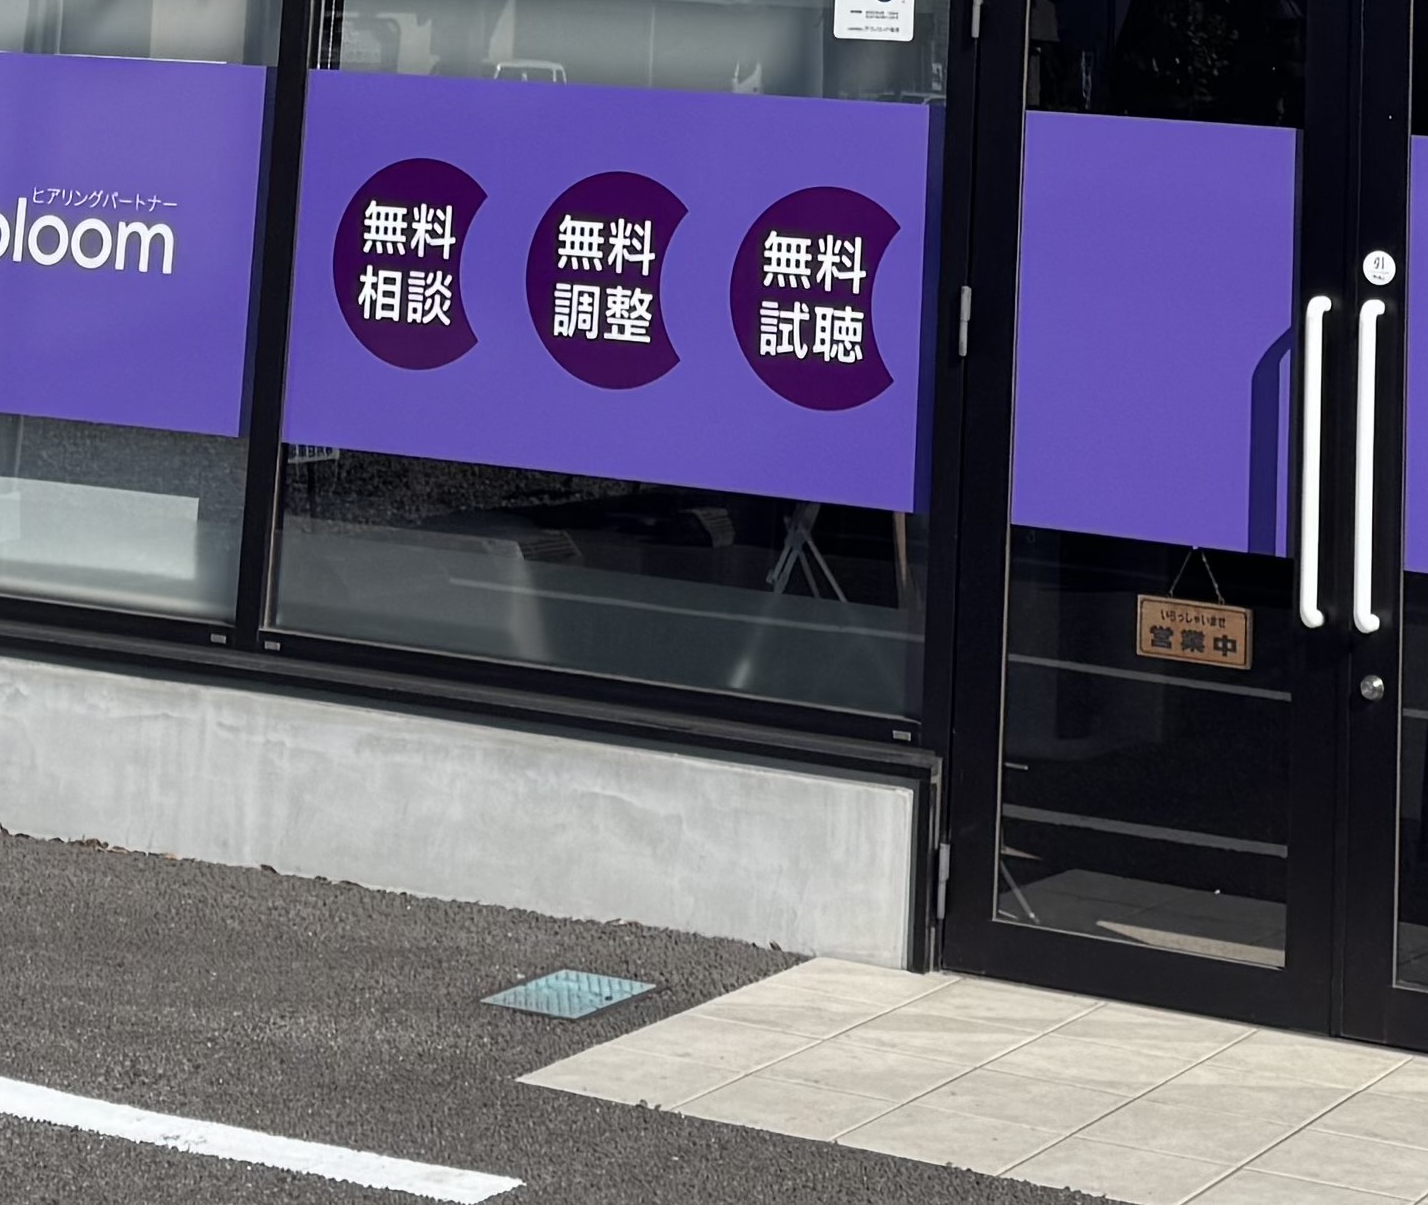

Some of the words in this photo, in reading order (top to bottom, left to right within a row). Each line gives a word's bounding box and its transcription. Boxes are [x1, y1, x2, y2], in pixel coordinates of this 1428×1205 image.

[32, 187, 178, 212] ヒアリングパートナー
[363, 200, 456, 260] 無料
[558, 214, 656, 276] 無料
[763, 230, 867, 294] 無料
[358, 265, 453, 326] 相談
[553, 283, 653, 343] 調整
[759, 301, 864, 363] 試聴
[1149, 625, 1238, 657] 営業中
[1160, 610, 1227, 628] いらっしゃいませ
